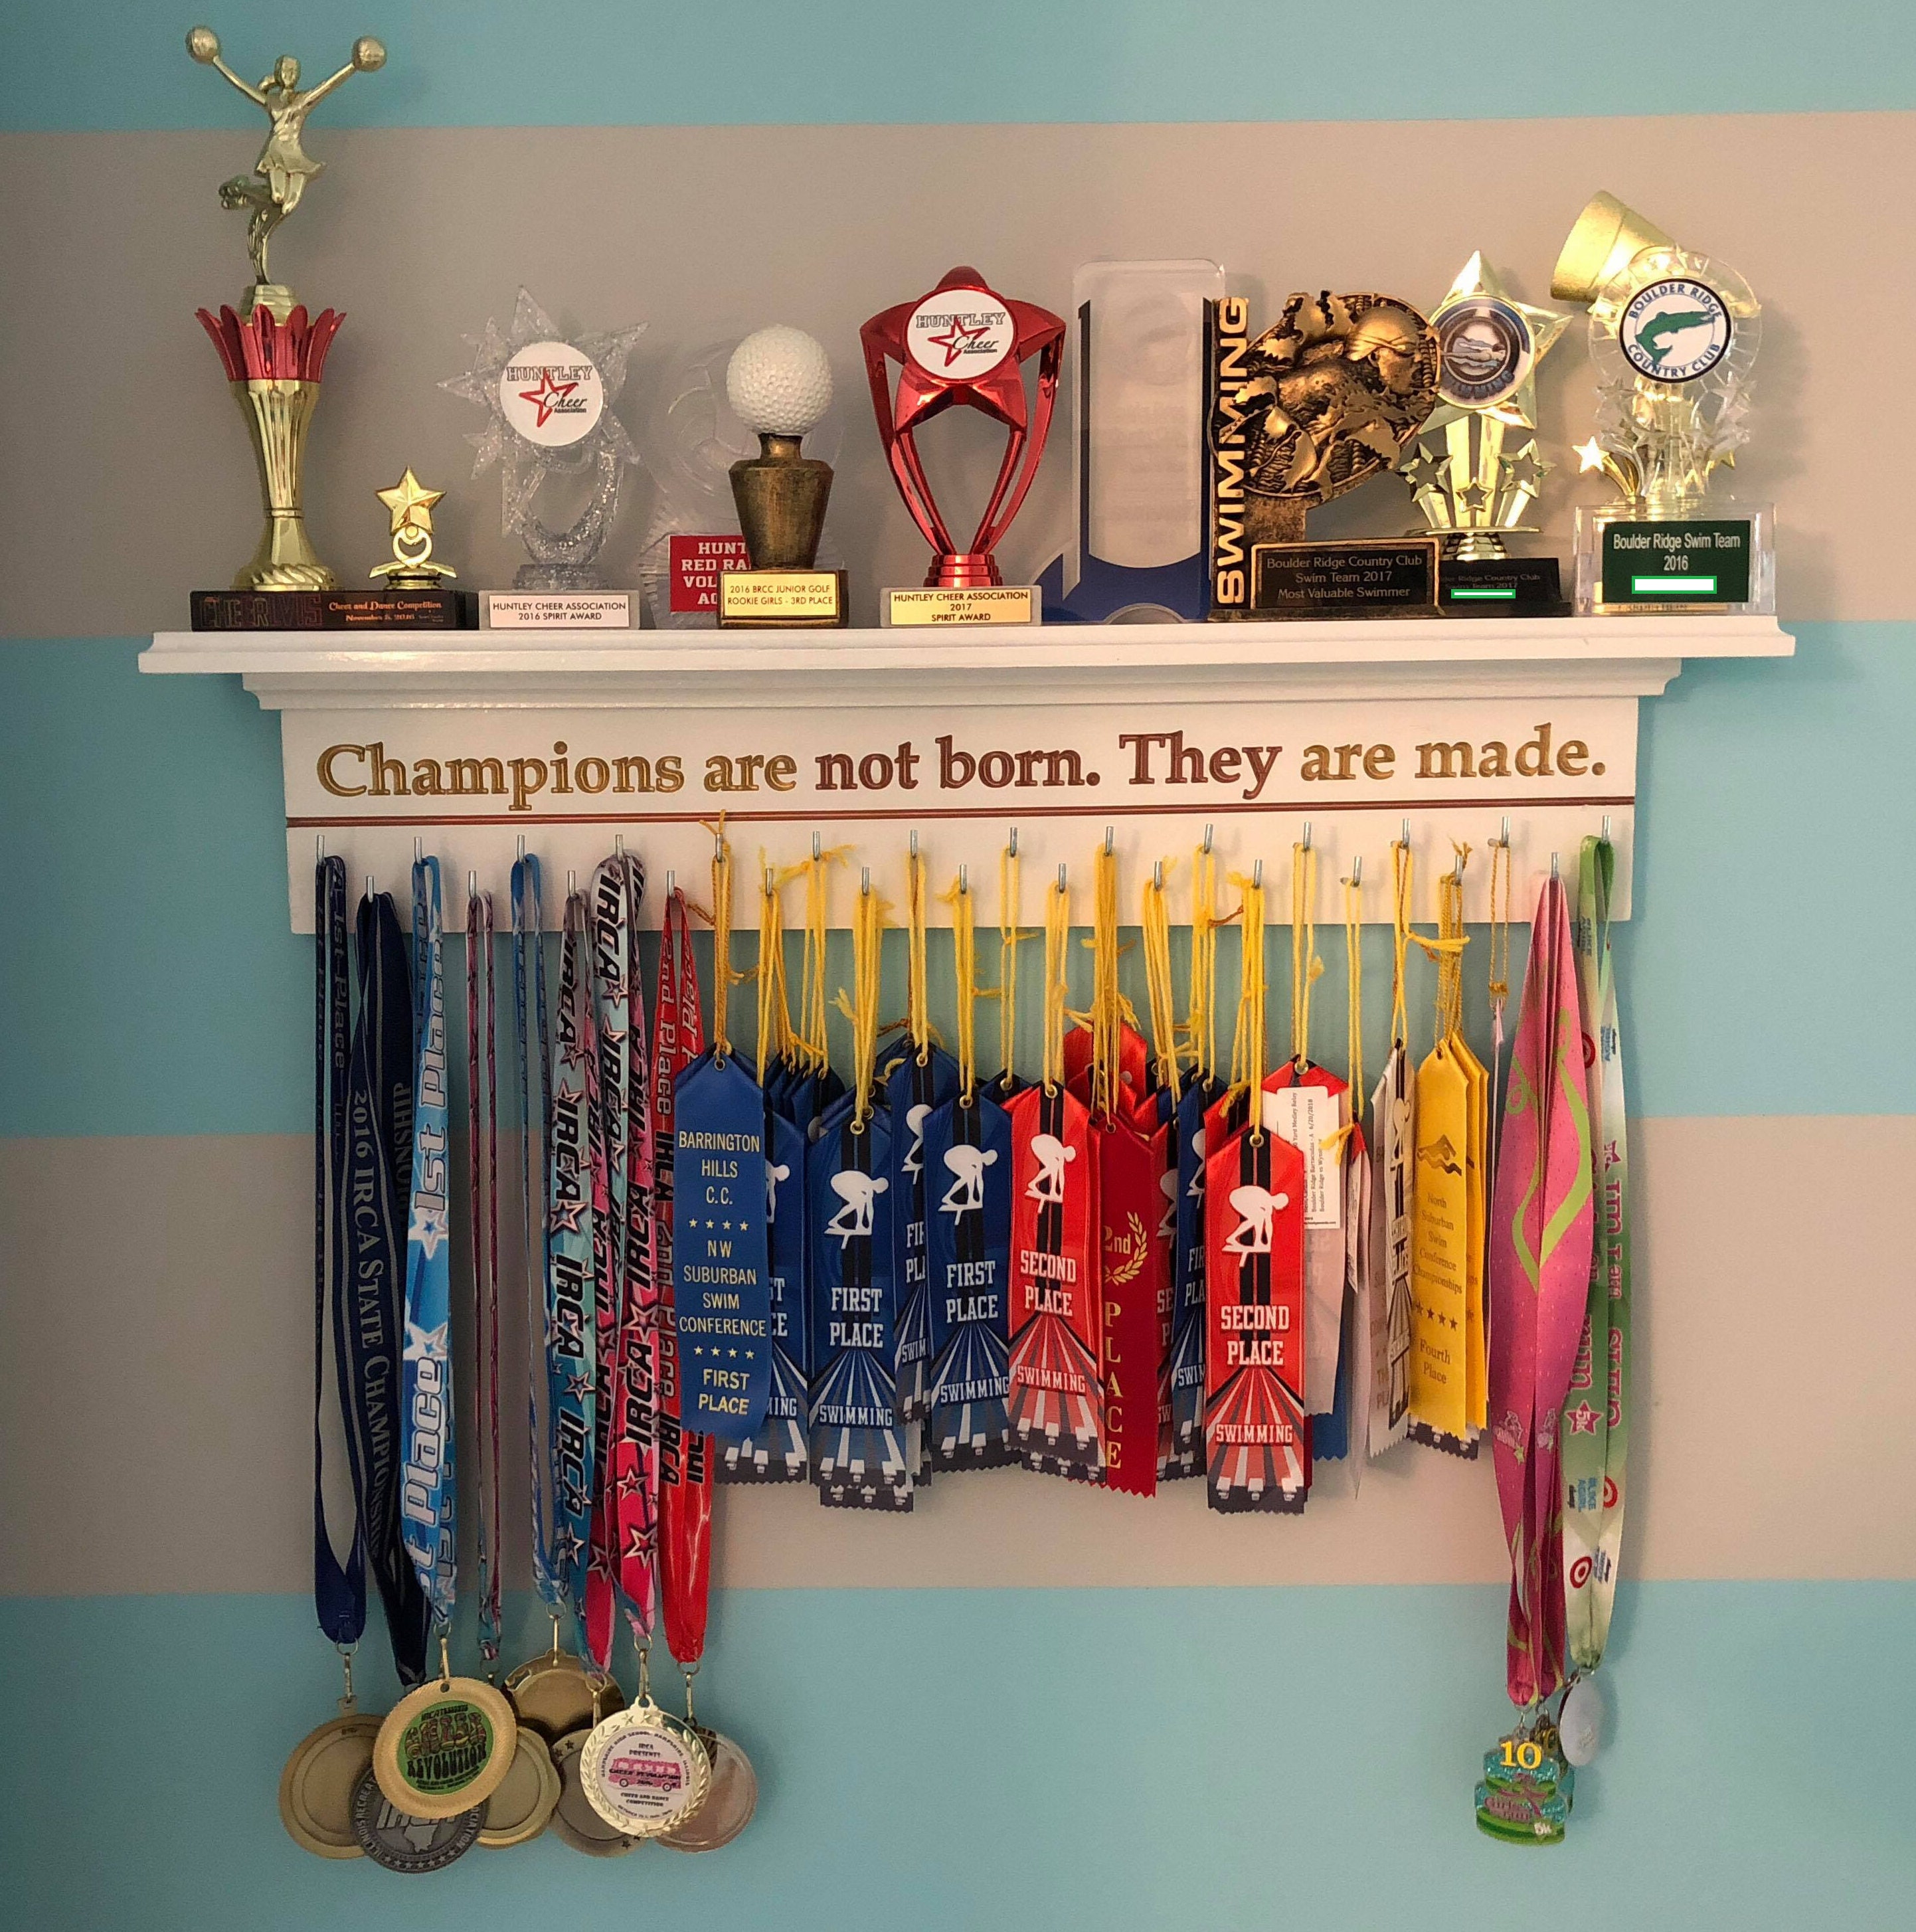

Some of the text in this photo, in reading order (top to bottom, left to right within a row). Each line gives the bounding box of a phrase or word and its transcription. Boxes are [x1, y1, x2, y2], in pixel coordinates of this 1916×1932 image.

[1628, 284, 1721, 319] BOULDER RIDGE
[916, 312, 1005, 328] HUNTLEY
[953, 335, 999, 349] Cheer
[1628, 343, 1720, 377] COUNTRY CLUB
[507, 366, 592, 381] HUNTLEY
[543, 392, 587, 408] Cheer
[1217, 298, 1249, 605] SWIMMING
[698, 542, 746, 555] HUNT
[1613, 533, 1741, 551] Boulder Ridge Swim Team
[681, 559, 717, 571] RED
[1267, 555, 1423, 570] Boulder Ridge Country Club
[1664, 555, 1689, 571] 2016
[683, 576, 717, 588] VOL
[1296, 571, 1392, 584] Swim Team 2017
[727, 596, 758, 605] ROOKIE
[894, 591, 1028, 602] HUNTLEY CHEER ASSOCIATION
[1278, 586, 1411, 599] Most Valuable Swimmer
[353, 602, 367, 610] and
[370, 601, 395, 611] Dance
[397, 600, 442, 612] Competition
[566, 602, 626, 610] ASSOCIATION
[317, 722, 1607, 811] Champions are not born. They are made.
[597, 874, 621, 982] IRCA
[559, 940, 576, 1045] IRCA
[333, 973, 348, 1069] Place
[414, 938, 447, 1211] 1st Place
[657, 1017, 677, 1116] Place
[599, 1036, 622, 1149] IRCA
[353, 1089, 373, 1158] 2016
[555, 1098, 580, 1199] IRCA
[679, 1131, 760, 1152] BARRINGTON
[701, 1159, 738, 1178] HILLS
[353, 1164, 381, 1253] IRCA
[1427, 1193, 1447, 1209] North
[1421, 1209, 1454, 1231] Suburban
[626, 1180, 651, 1289] IRCA
[1103, 1226, 1131, 1254] 2nd
[1428, 1231, 1447, 1249] Swim
[1020, 1249, 1077, 1282] SECOND
[1419, 1249, 1456, 1271] Conference
[683, 1265, 756, 1285] SUBURBAN
[946, 1261, 996, 1288] FIRST
[1413, 1265, 1462, 1294] Championships
[358, 1260, 384, 1349] STATE
[555, 1254, 584, 1360] IRCA
[703, 1292, 740, 1310] SWIM
[831, 1287, 883, 1312] FIRST
[946, 1294, 998, 1324] PLACE
[1025, 1284, 1073, 1317] PLACE
[679, 1316, 766, 1337] CONFERENCE
[1221, 1305, 1290, 1330] SECOND
[829, 1322, 883, 1348] PLACE
[901, 1338, 926, 1363] SWIM
[1227, 1340, 1284, 1365] PLACE
[1420, 1338, 1450, 1363] Fourth
[703, 1368, 750, 1391] FIRST
[1017, 1365, 1086, 1394] SWIMMING
[1423, 1363, 1447, 1384] Place
[624, 1340, 653, 1449] IRCA
[940, 1375, 1009, 1403] SWIMMING
[699, 1393, 750, 1415] PLACE
[819, 1406, 893, 1427] SWIMMING
[403, 1356, 443, 1527] Place
[1216, 1424, 1293, 1443] SWIMMING
[659, 1411, 681, 1486] IRCA
[559, 1407, 585, 1520] IRCA
[1500, 1740, 1542, 1769] 10
